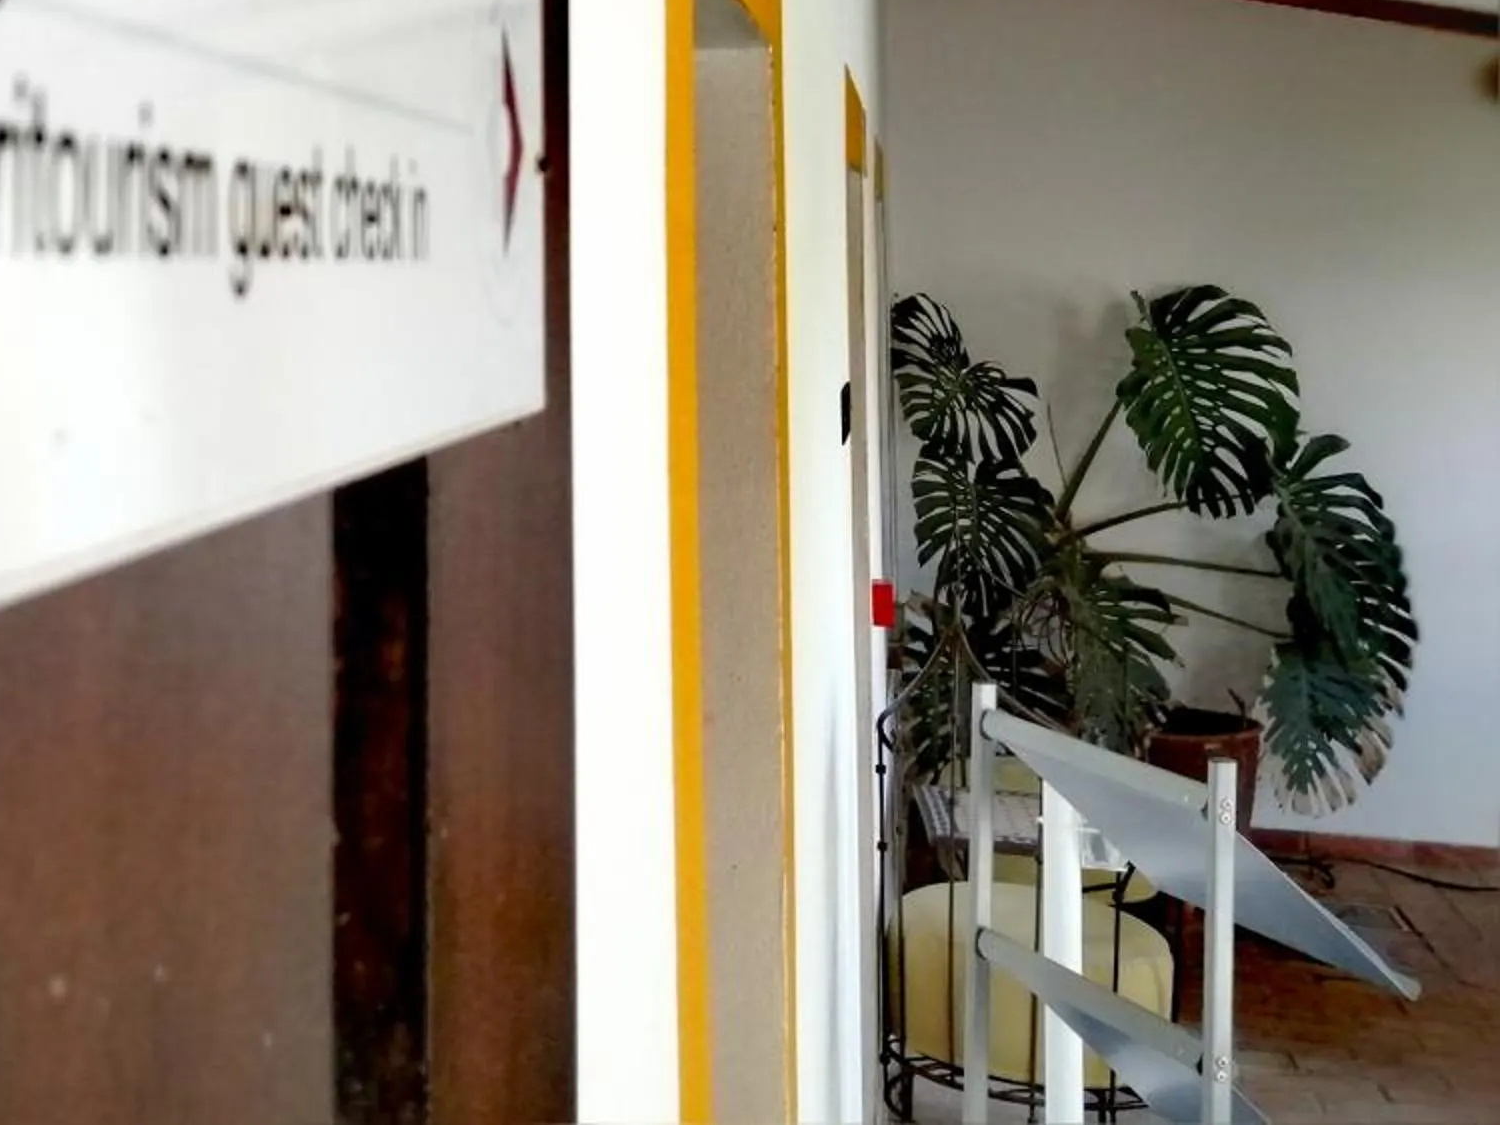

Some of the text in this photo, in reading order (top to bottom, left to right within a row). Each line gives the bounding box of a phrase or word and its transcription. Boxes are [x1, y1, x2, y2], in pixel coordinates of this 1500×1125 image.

[227, 143, 323, 297] guest
[330, 142, 401, 261] check
[406, 157, 429, 261] in
